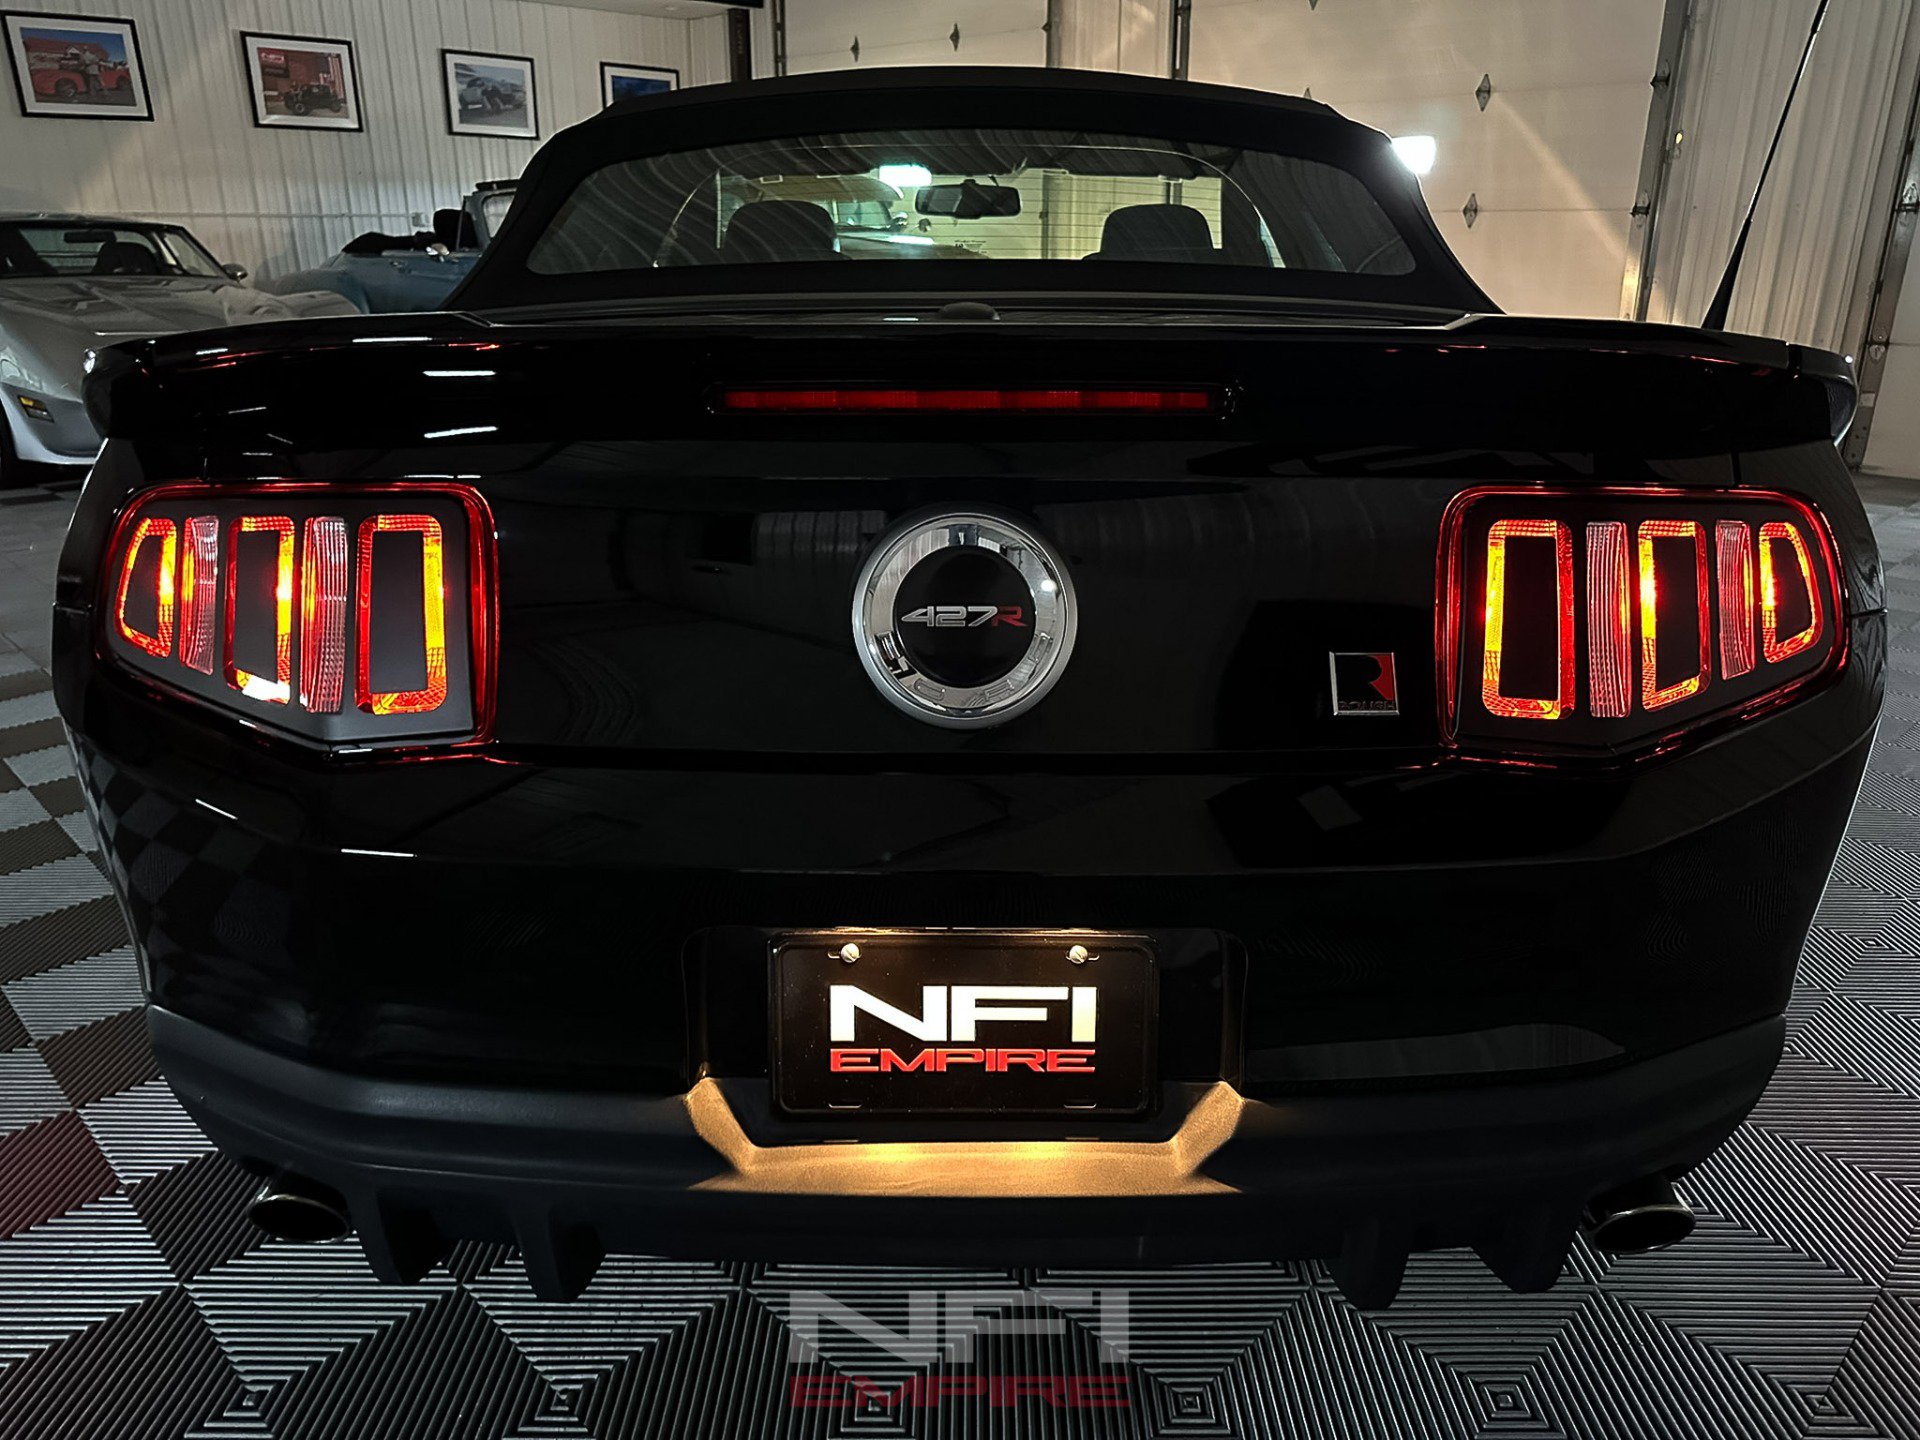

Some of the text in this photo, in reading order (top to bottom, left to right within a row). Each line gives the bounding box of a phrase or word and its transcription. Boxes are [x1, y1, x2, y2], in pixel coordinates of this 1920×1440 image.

[901, 605, 1028, 628] 427R
[829, 984, 1097, 1043] NFI
[829, 1048, 1097, 1073] EMPIRE
